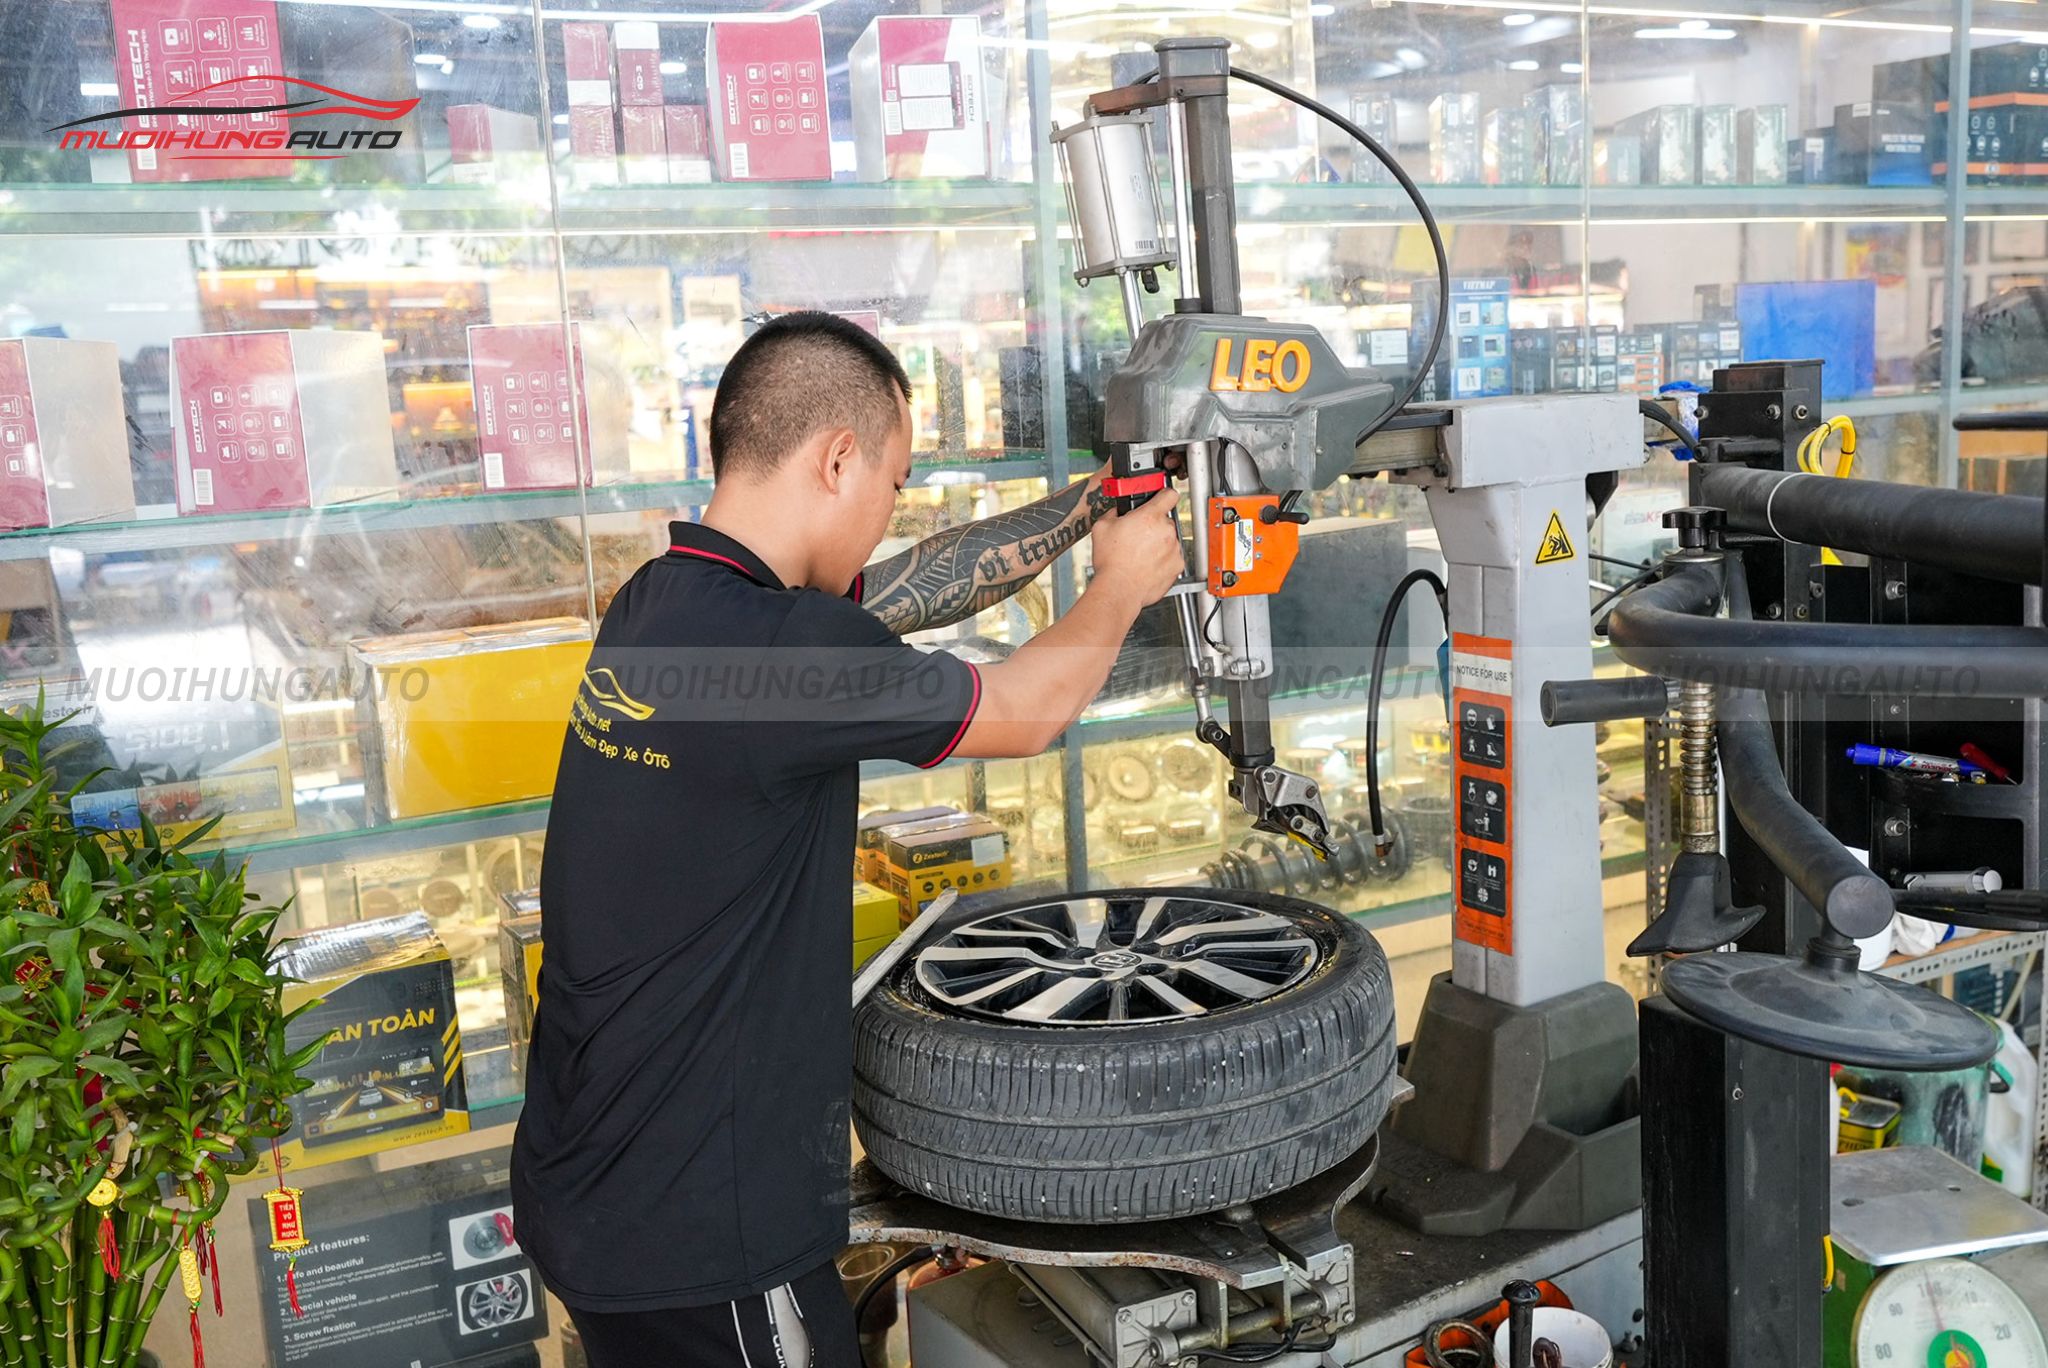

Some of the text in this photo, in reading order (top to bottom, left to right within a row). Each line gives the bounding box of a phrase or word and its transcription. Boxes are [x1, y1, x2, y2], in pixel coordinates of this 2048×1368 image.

[1209, 338, 1312, 393] LEO
[1456, 665, 1508, 682] NOTICE FOR USE
[598, 739, 618, 759] Đẹp
[623, 745, 639, 762] Xe
[325, 1008, 435, 1046] AN TOÀN
[274, 1234, 370, 1262] Product features:
[306, 1267, 323, 1277] and
[324, 1257, 364, 1272] beautiful
[280, 1308, 289, 1316] 2.
[325, 1293, 357, 1305] vehicle
[1888, 1302, 1903, 1317] 90
[283, 1321, 356, 1343] 3. Screw fixation
[1994, 1323, 2012, 1340] 20
[1875, 1342, 1893, 1360] 80
